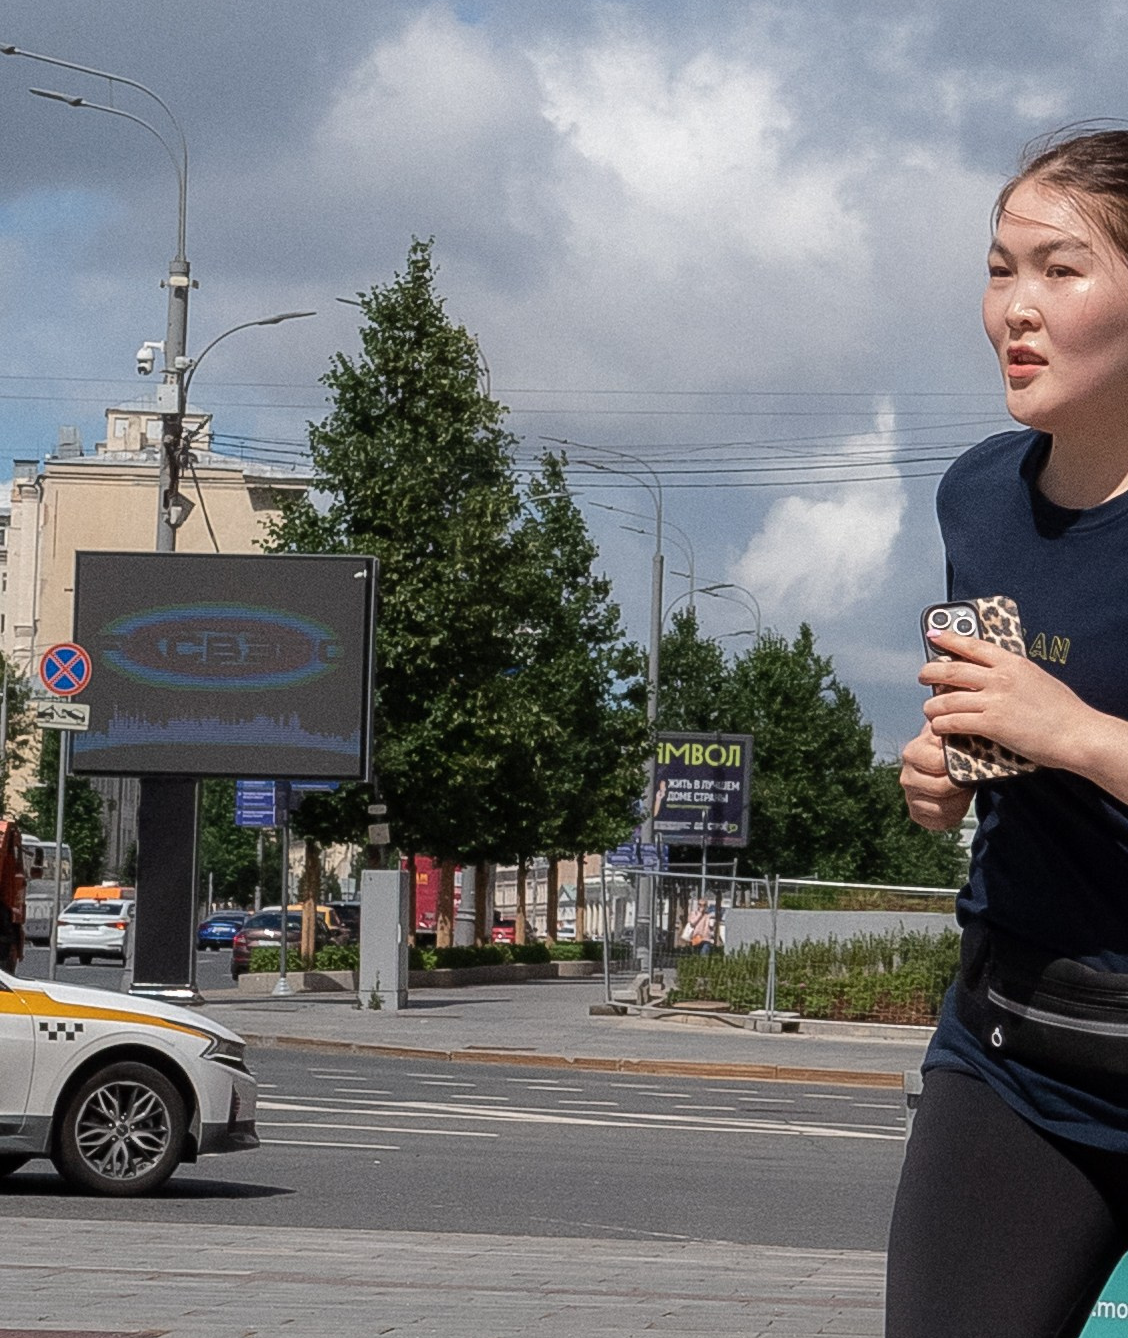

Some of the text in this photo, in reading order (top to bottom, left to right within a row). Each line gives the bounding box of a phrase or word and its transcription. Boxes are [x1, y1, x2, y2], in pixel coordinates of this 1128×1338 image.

[1022, 627, 1071, 664] AN
[667, 779, 693, 790] ЖИТЬ
[693, 780, 701, 790] В
[666, 791, 693, 802] ДОМЕ
